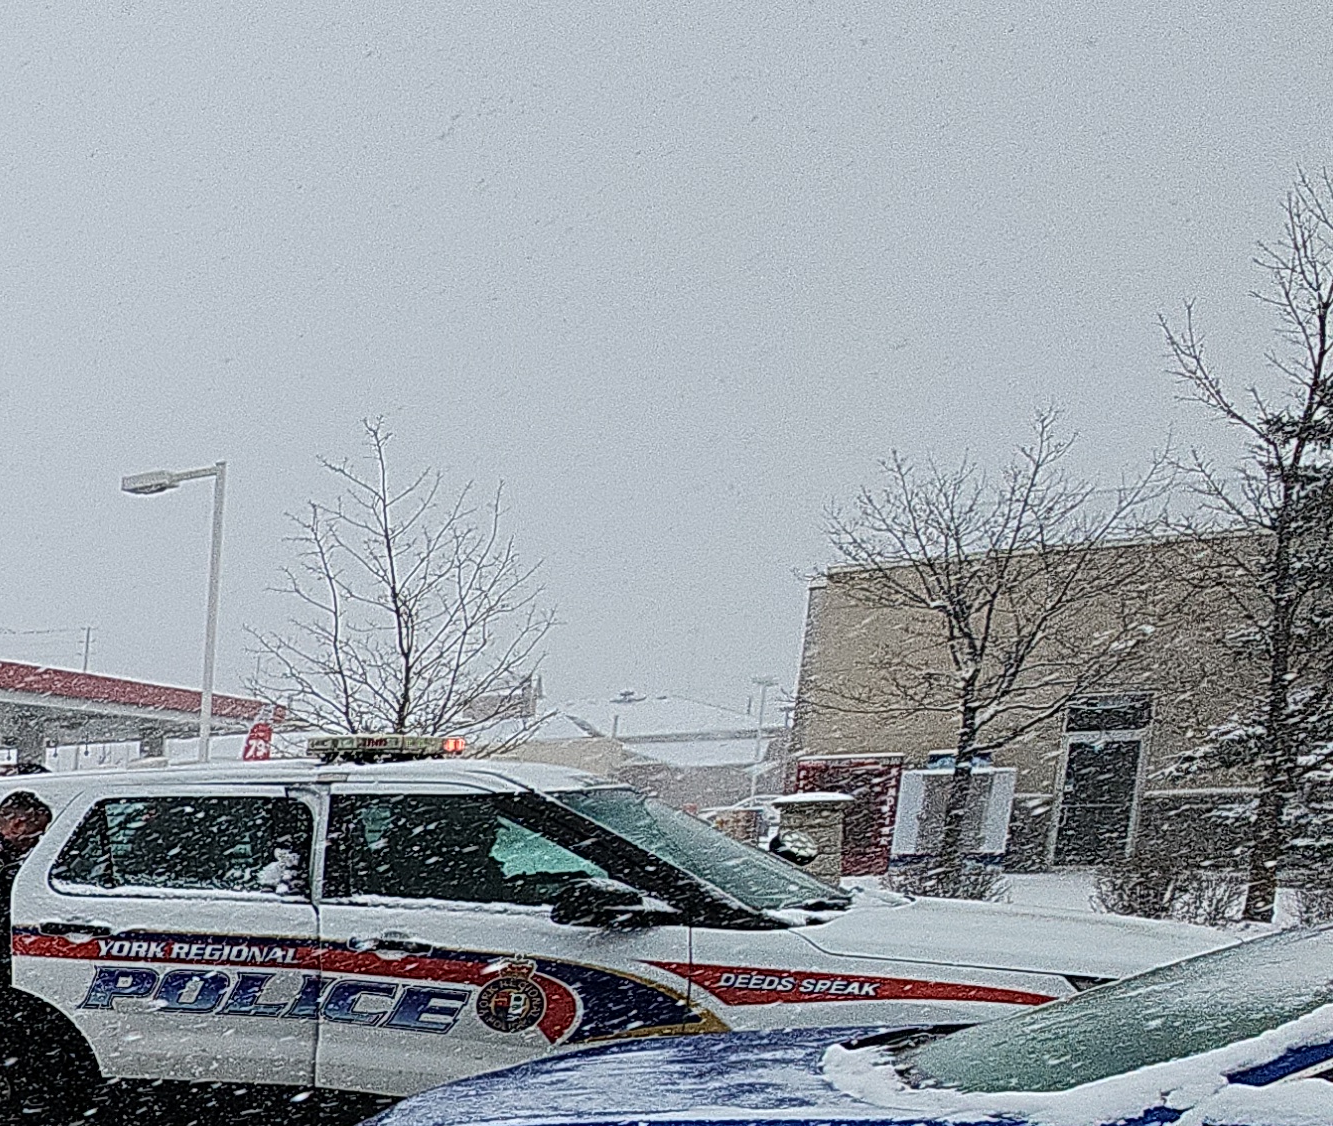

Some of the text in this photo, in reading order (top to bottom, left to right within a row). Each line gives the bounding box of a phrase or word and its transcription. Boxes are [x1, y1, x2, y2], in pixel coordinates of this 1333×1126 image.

[96, 939, 301, 965] YORK REGIONAL
[718, 972, 881, 996] DEEDS SPEAK
[78, 965, 471, 1035] POLICE
